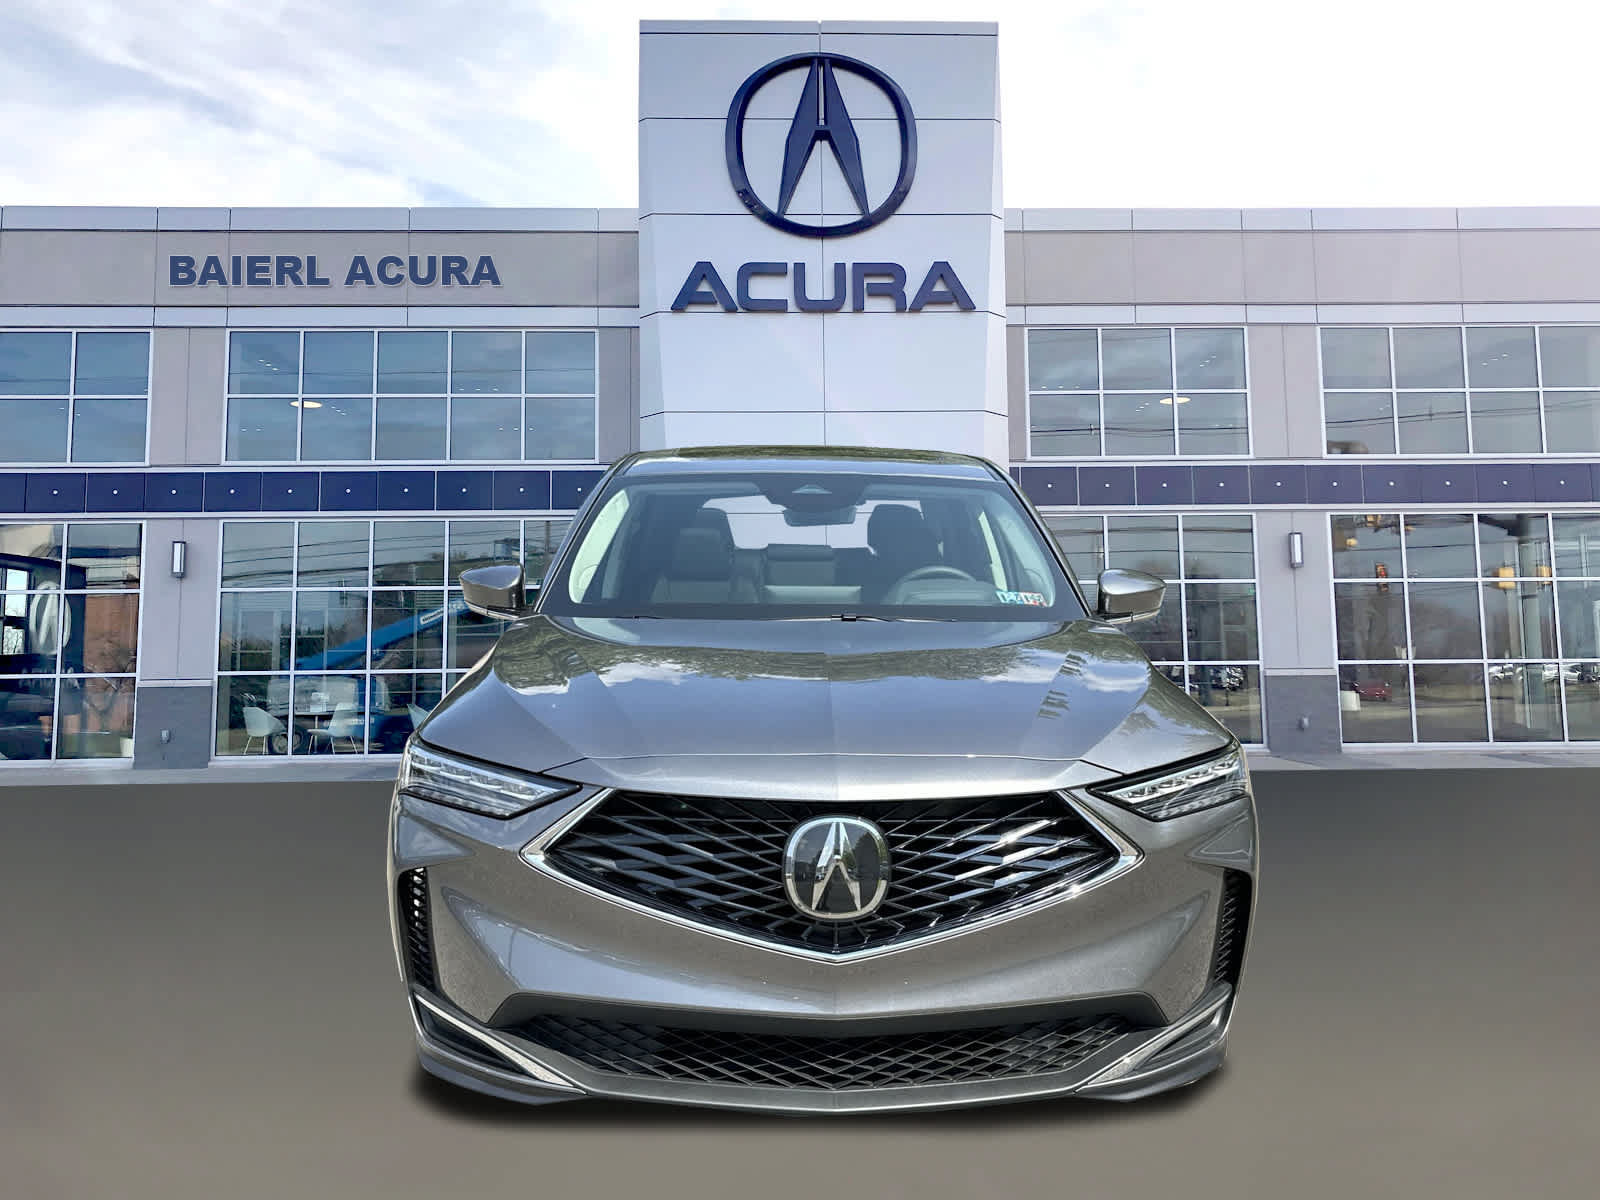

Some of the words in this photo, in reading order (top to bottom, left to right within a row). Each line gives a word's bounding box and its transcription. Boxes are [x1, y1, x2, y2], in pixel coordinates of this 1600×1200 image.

[170, 255, 330, 287] BAIERL
[344, 255, 501, 287] ACURA
[671, 261, 976, 313] ACURA
